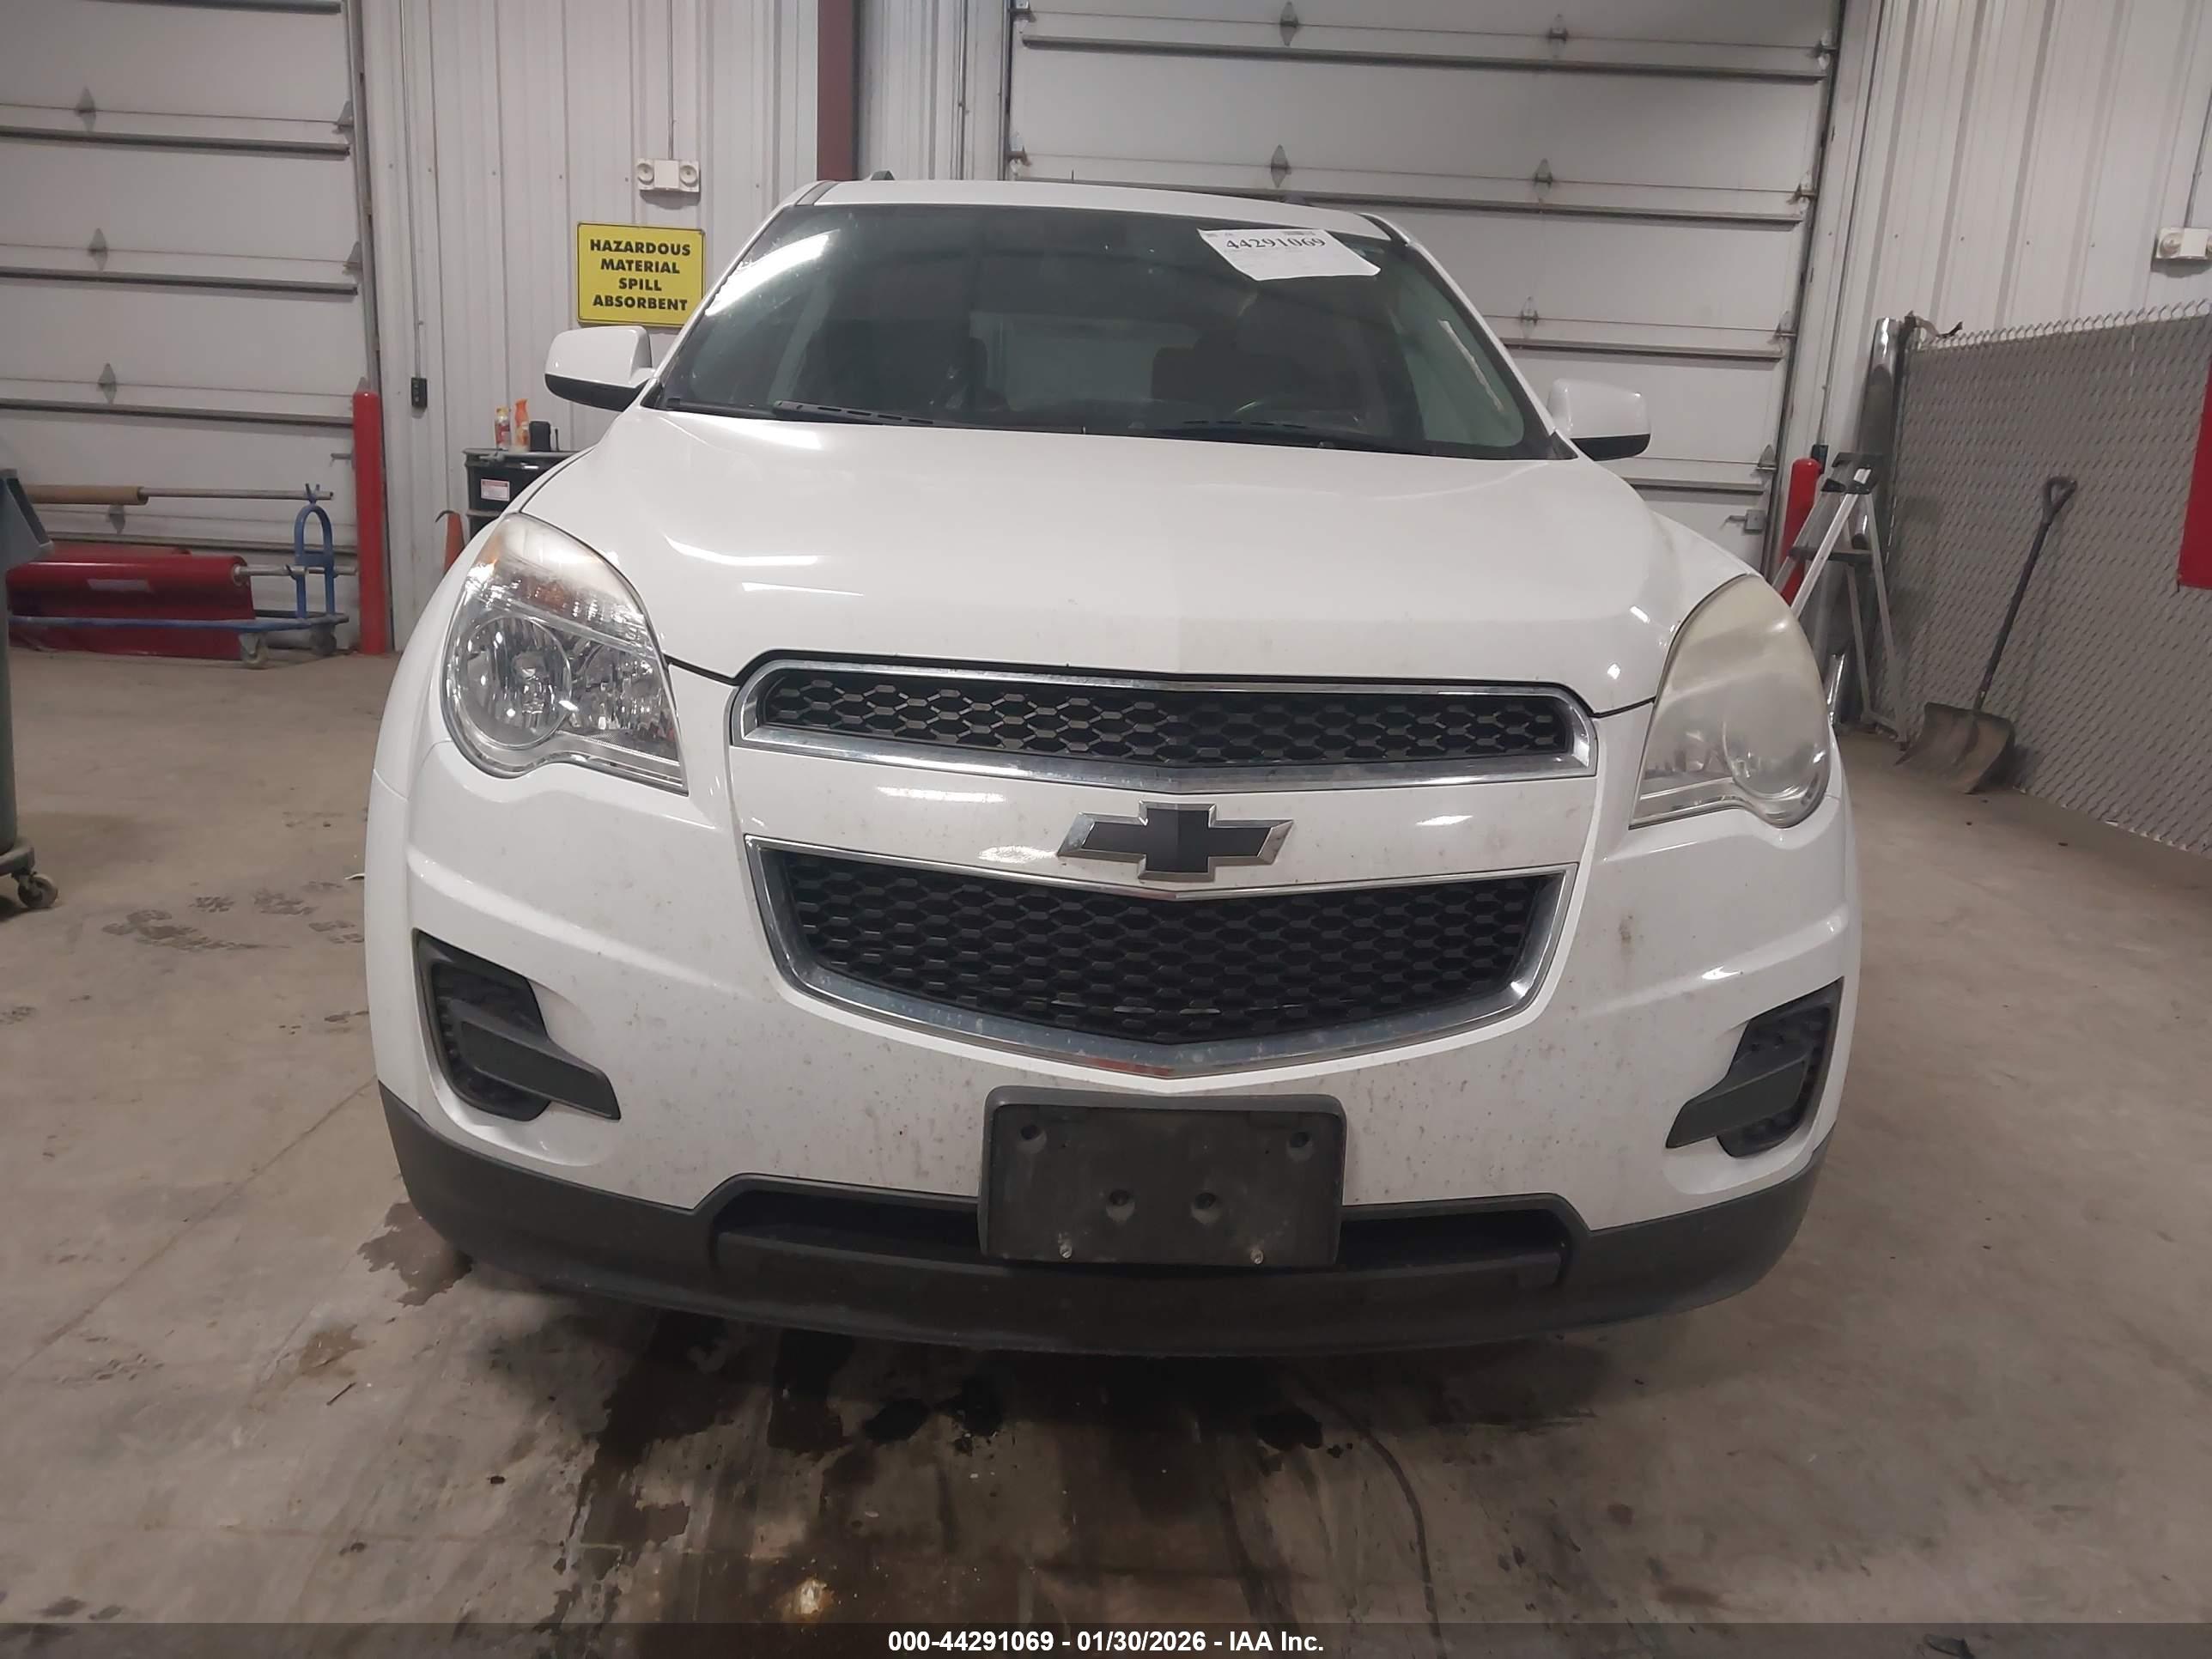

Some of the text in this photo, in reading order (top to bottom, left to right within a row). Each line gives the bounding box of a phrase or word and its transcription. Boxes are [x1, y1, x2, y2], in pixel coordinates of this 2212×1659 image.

[590, 239, 690, 256] HAZARDOUS
[1226, 237, 1326, 249] 44291069
[600, 258, 680, 274] MATERIAL
[618, 277, 662, 291] SPILL
[592, 295, 688, 311] ABSORBENT
